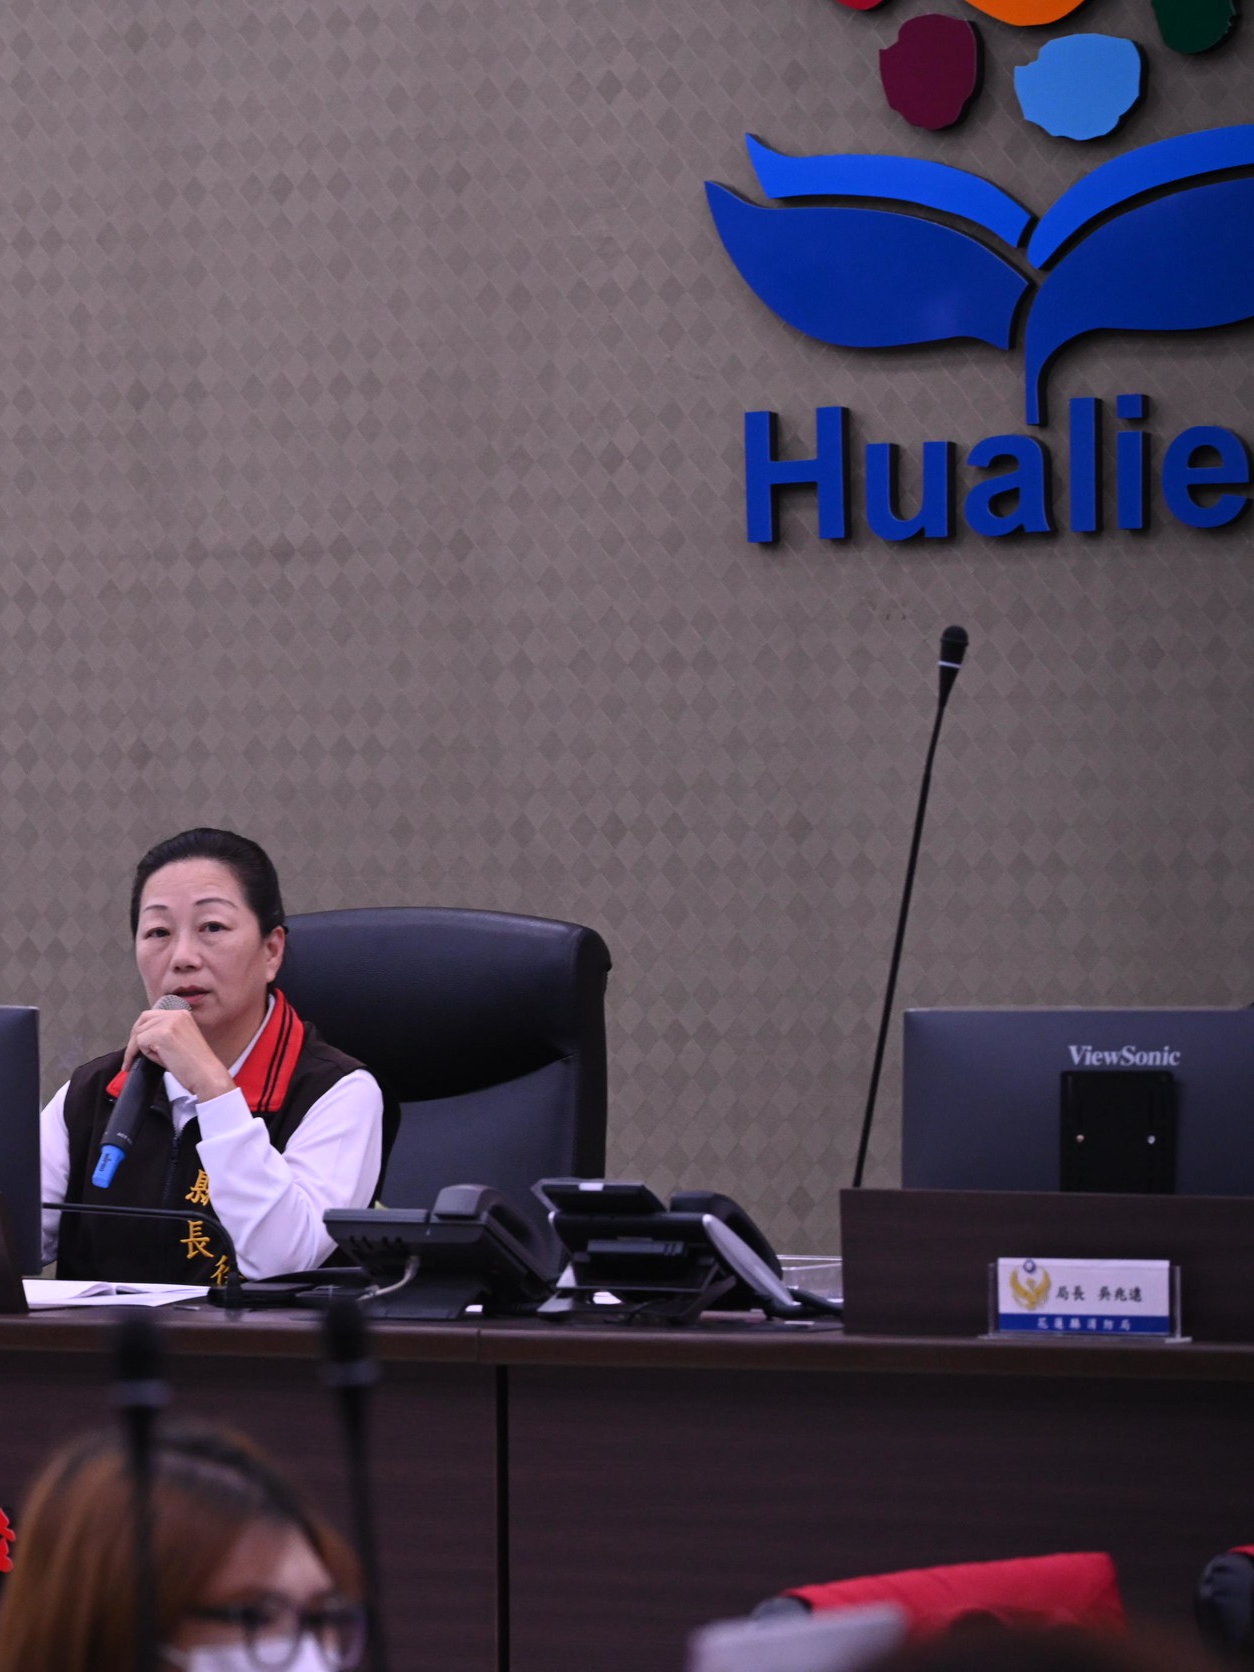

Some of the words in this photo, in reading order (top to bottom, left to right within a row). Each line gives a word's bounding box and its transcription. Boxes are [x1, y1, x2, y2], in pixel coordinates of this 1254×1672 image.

[744, 393, 1253, 544] Hualie
[1067, 1044, 1182, 1067] ViewSonic
[1055, 1285, 1086, 1302] 局長
